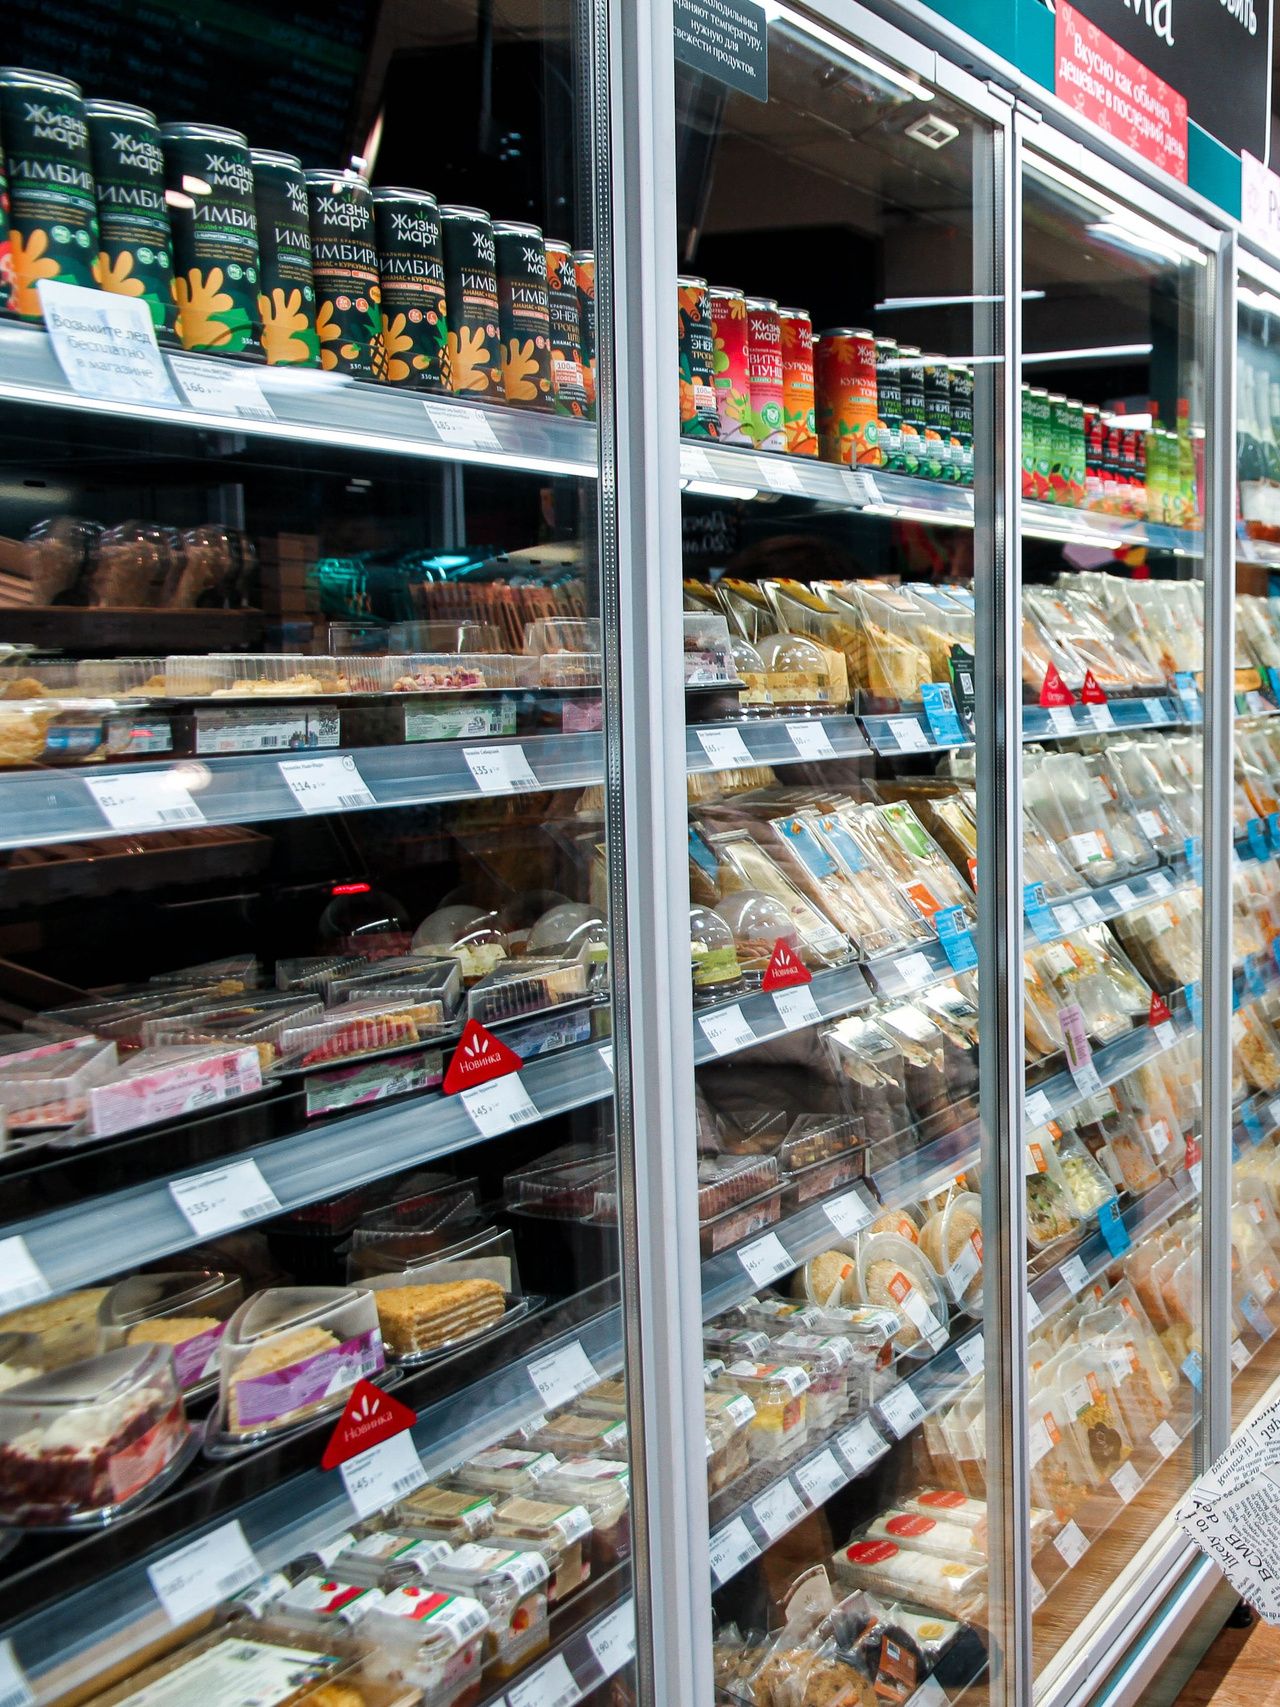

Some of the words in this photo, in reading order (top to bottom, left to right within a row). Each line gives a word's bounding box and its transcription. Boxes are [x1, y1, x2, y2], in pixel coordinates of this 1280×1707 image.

[691, 19, 724, 43] нужную
[724, 37, 739, 53] для
[711, 13, 763, 52] температуру,
[673, 25, 712, 54] свежести
[713, 47, 757, 77] продуктов.
[1073, 32, 1113, 82] Вкусно
[1114, 69, 1132, 98] как
[1133, 82, 1172, 129] обычно,
[1058, 56, 1106, 104] дешевле
[1105, 91, 1113, 109] в
[1113, 94, 1165, 145] последний
[1163, 133, 1186, 161] день
[316, 197, 370, 219] Жизнь
[323, 213, 369, 232] март
[391, 213, 439, 235] Жизнь
[398, 230, 437, 248] март
[52, 313, 122, 338] Возьмите
[126, 329, 152, 344] лед
[68, 335, 144, 360] бесплатно
[89, 359, 153, 379] магазине
[421, 373, 432, 381] 330
[434, 420, 451, 431] 185
[472, 765, 489, 775] 135
[291, 781, 311, 792] 114
[771, 966, 799, 978] Новинка
[459, 1052, 502, 1074] Новинка
[471, 1104, 488, 1119] 145
[746, 1260, 758, 1271] 145
[343, 1411, 394, 1442] Новинка
[1238, 1499, 1252, 1517] When
[1195, 1517, 1209, 1532] to
[710, 1553, 723, 1567] 190
[1207, 1535, 1239, 1569] likely
[1225, 1533, 1273, 1583] BCMB
